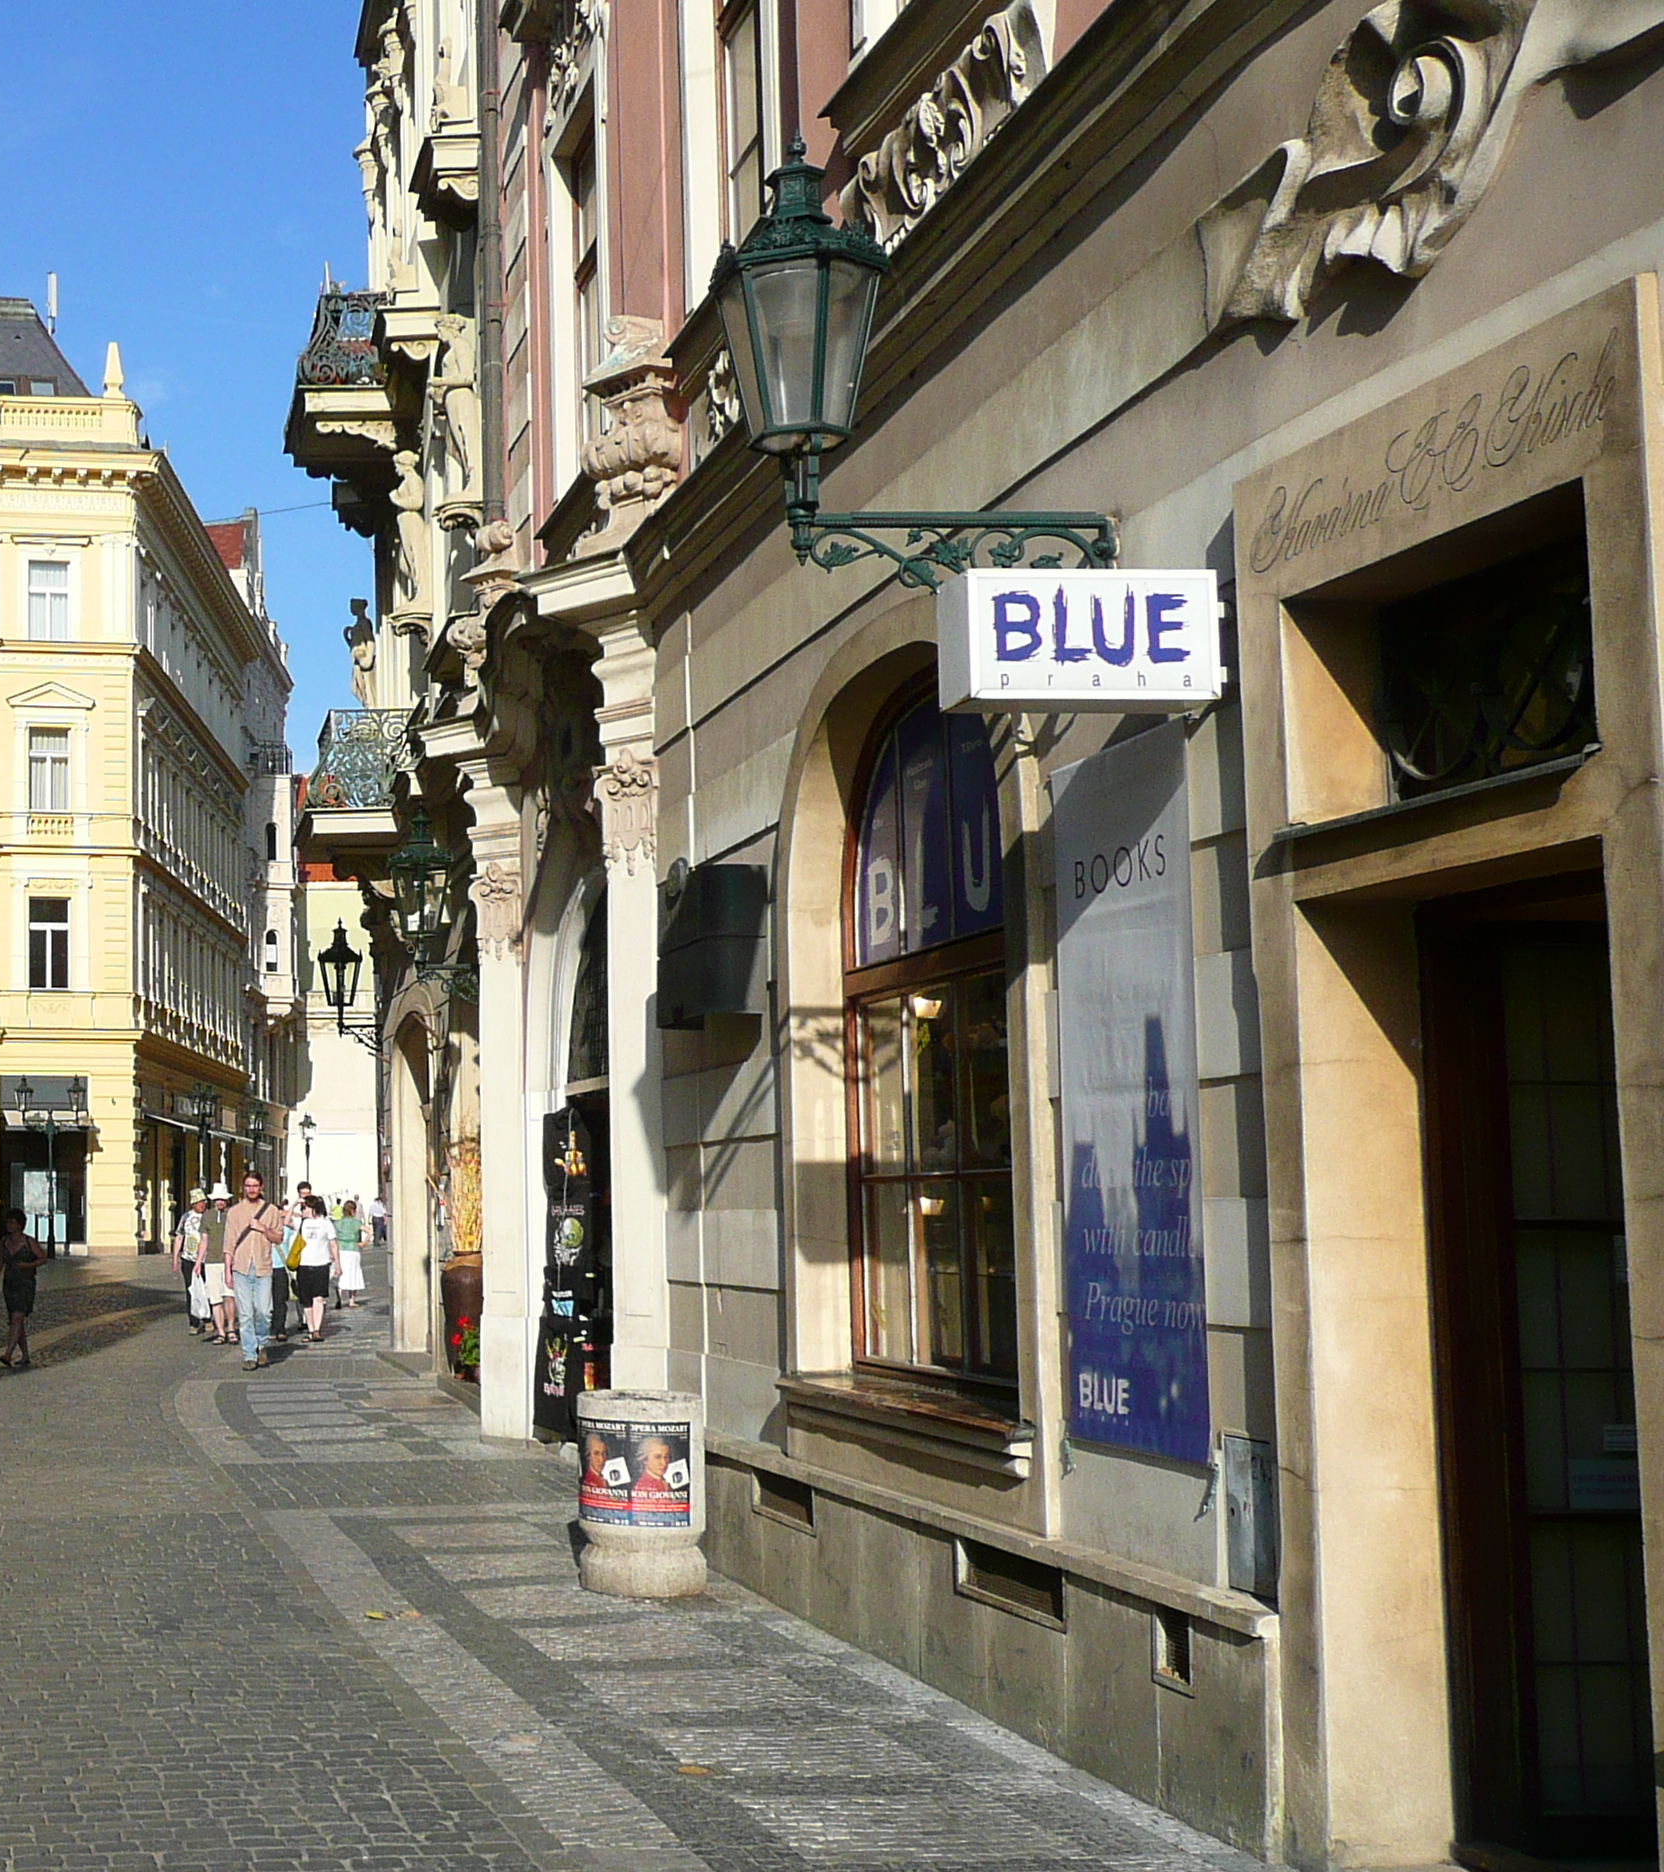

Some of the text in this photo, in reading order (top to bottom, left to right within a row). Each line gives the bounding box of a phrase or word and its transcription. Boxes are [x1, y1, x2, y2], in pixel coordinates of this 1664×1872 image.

[991, 584, 1193, 668] BLUE
[998, 670, 1194, 690] praha
[1074, 833, 1170, 901] BOOKS
[1134, 1146, 1165, 1188] the
[1084, 1281, 1160, 1335] Prague
[1078, 1370, 1132, 1416] BLUE
